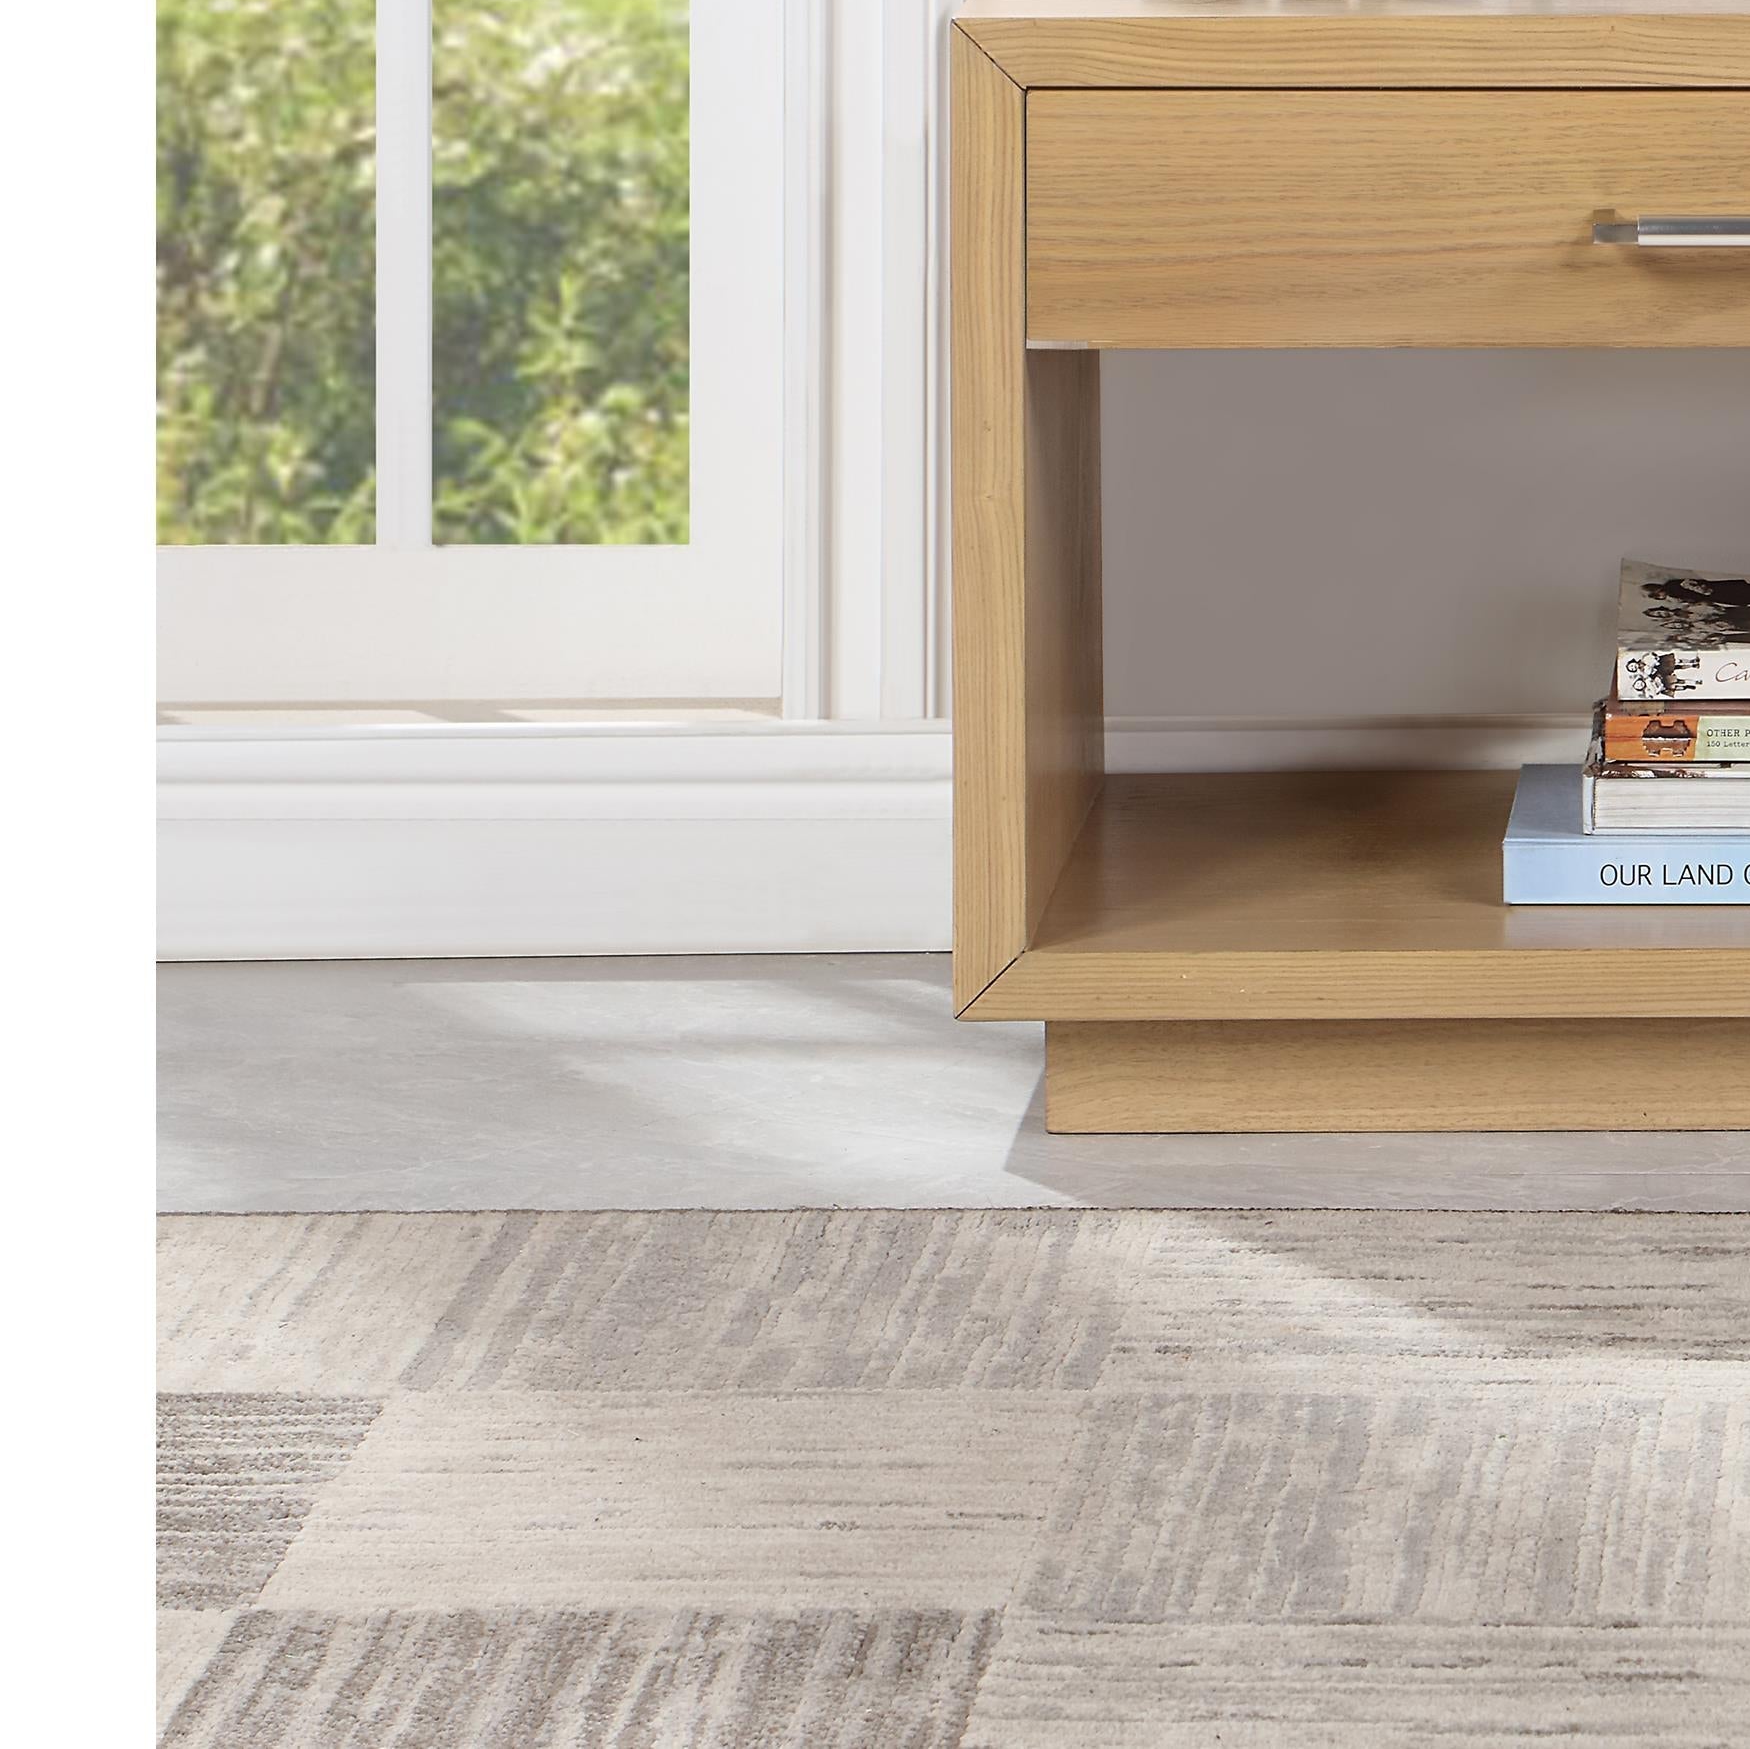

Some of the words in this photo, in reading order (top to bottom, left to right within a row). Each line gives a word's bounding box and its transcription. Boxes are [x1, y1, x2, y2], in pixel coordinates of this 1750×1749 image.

[1706, 729, 1740, 738] OTHER
[1600, 864, 1652, 886] OUR
[1663, 864, 1734, 885] LAND
